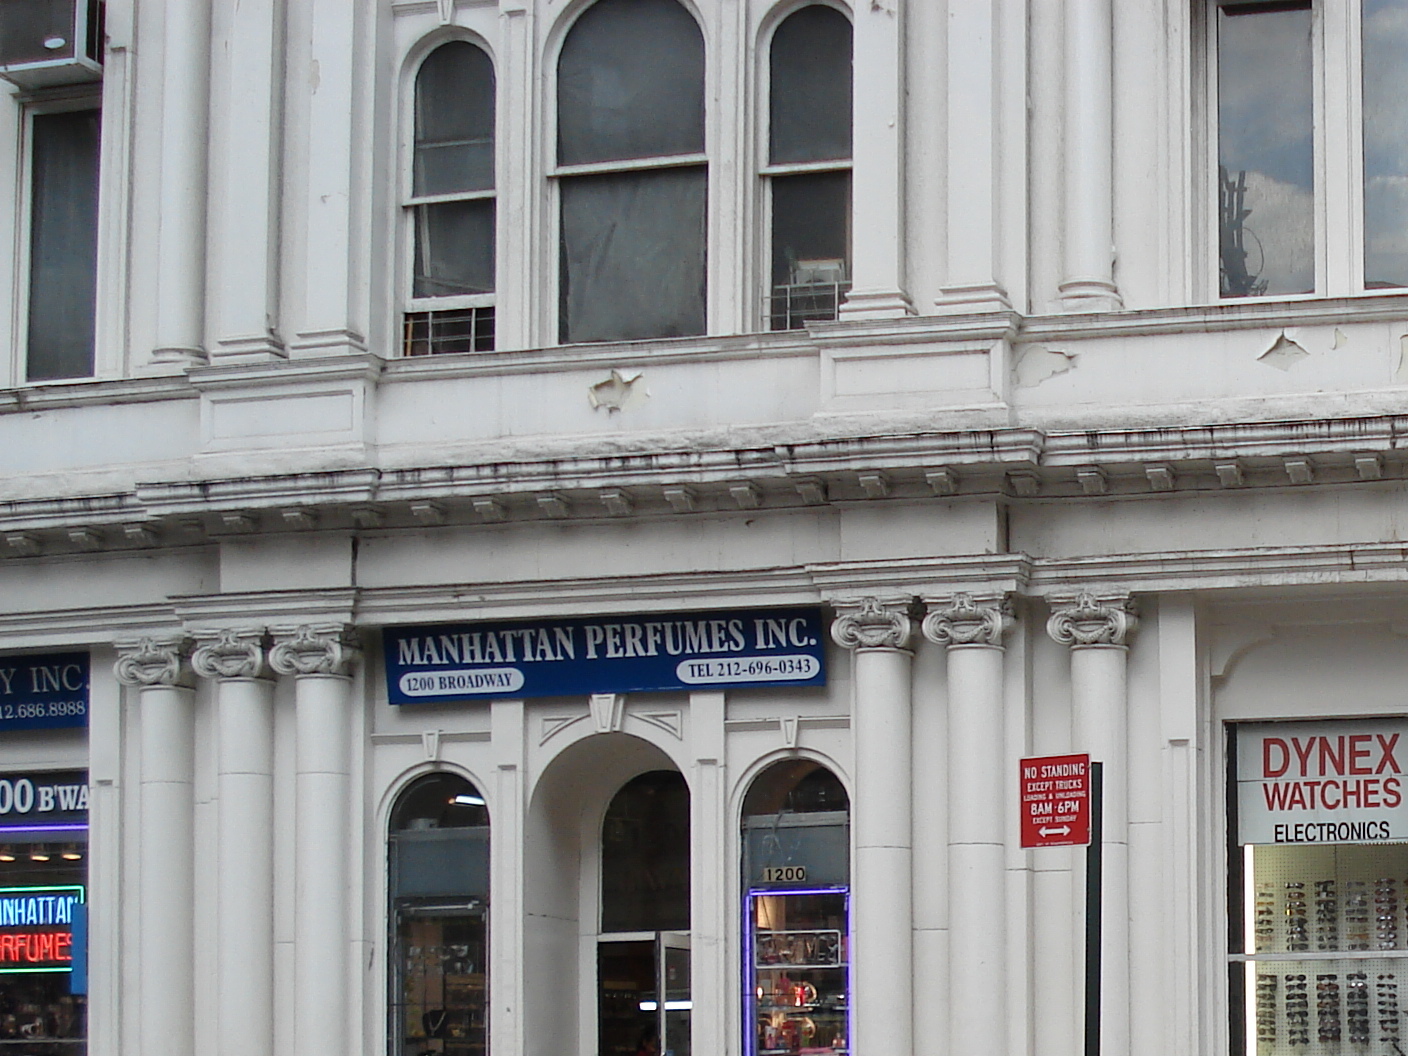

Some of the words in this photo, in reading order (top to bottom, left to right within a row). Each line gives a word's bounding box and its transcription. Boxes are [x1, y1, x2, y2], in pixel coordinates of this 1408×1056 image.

[398, 626, 575, 666] MANHATTAN
[584, 619, 745, 659] PERFUMES
[753, 618, 817, 649] INC.
[29, 664, 90, 693] INC.
[688, 663, 714, 678] TEL
[717, 658, 811, 677] 212-696-0343
[407, 676, 434, 691] 1200
[438, 673, 513, 691] BROADWAY
[1263, 733, 1402, 778] DYNEX
[1024, 766, 1037, 779] NO
[1041, 763, 1085, 778] STANDING
[1027, 781, 1053, 792] EXCEPT
[1055, 779, 1082, 790] TRUCKS
[1263, 778, 1402, 811] WATCHES
[1274, 820, 1390, 843] ELECTRONICS
[767, 867, 805, 880] 1200
